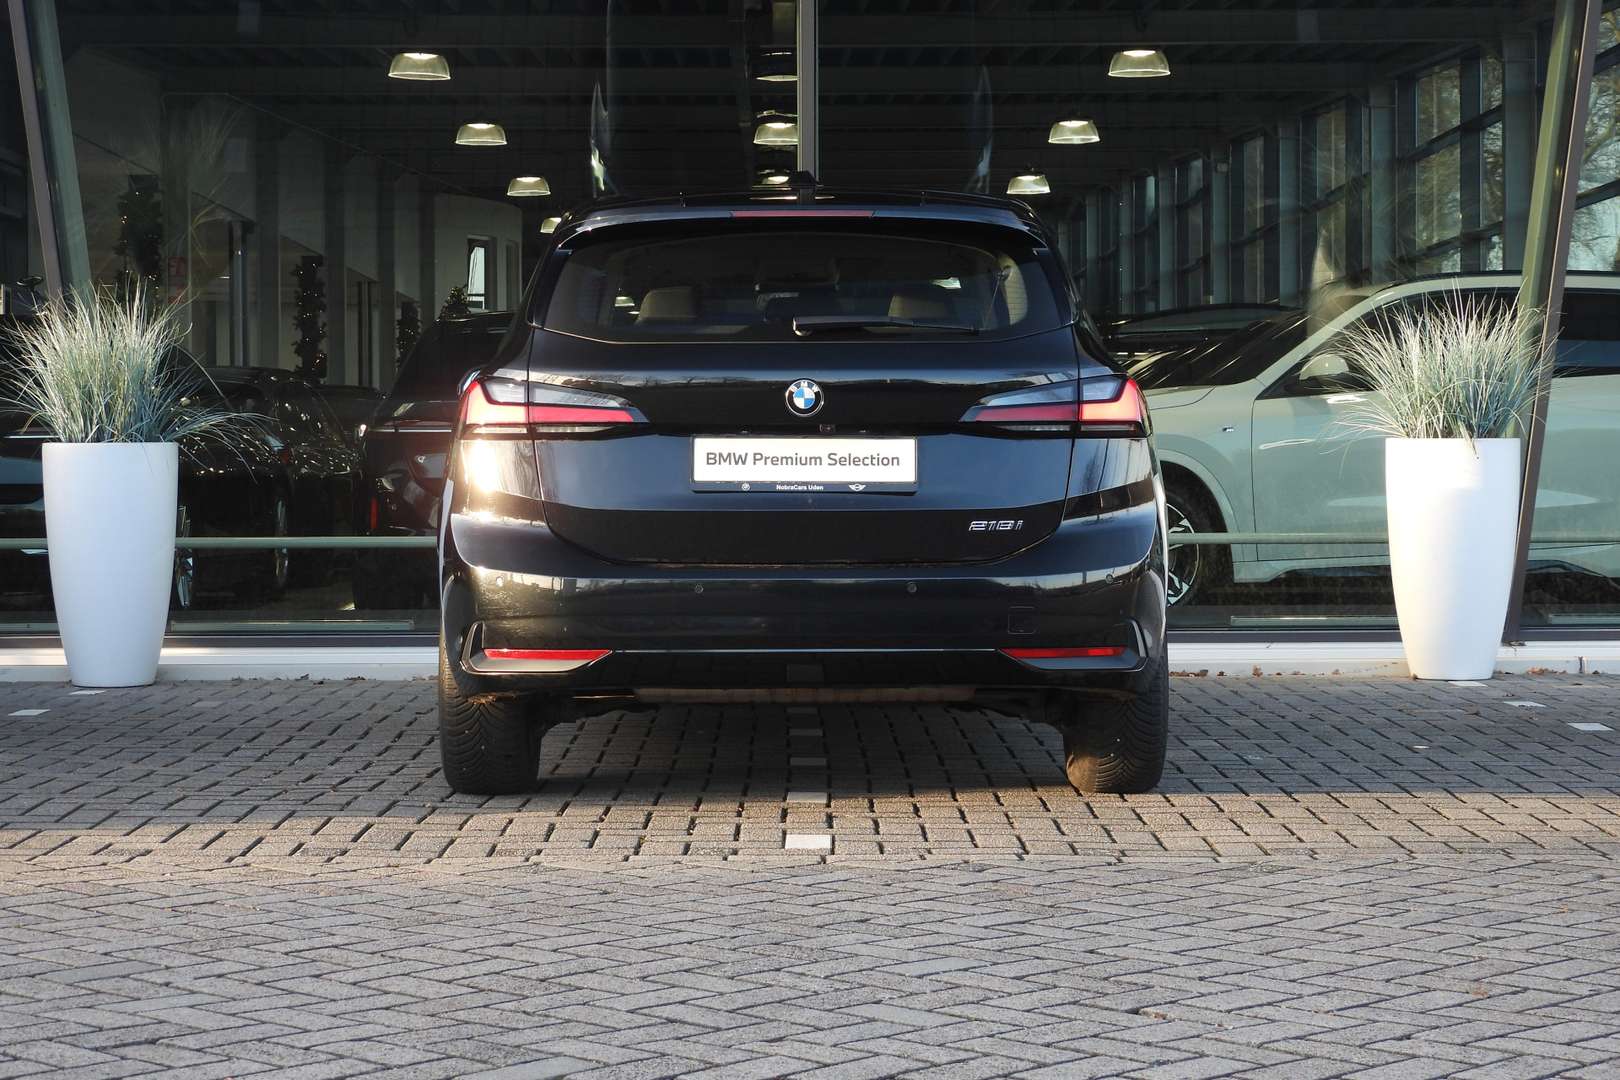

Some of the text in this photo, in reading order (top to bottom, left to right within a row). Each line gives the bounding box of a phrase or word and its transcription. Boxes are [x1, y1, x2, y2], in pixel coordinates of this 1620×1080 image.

[790, 380, 820, 393] BMW
[706, 452, 900, 467] BMW Premium Selection
